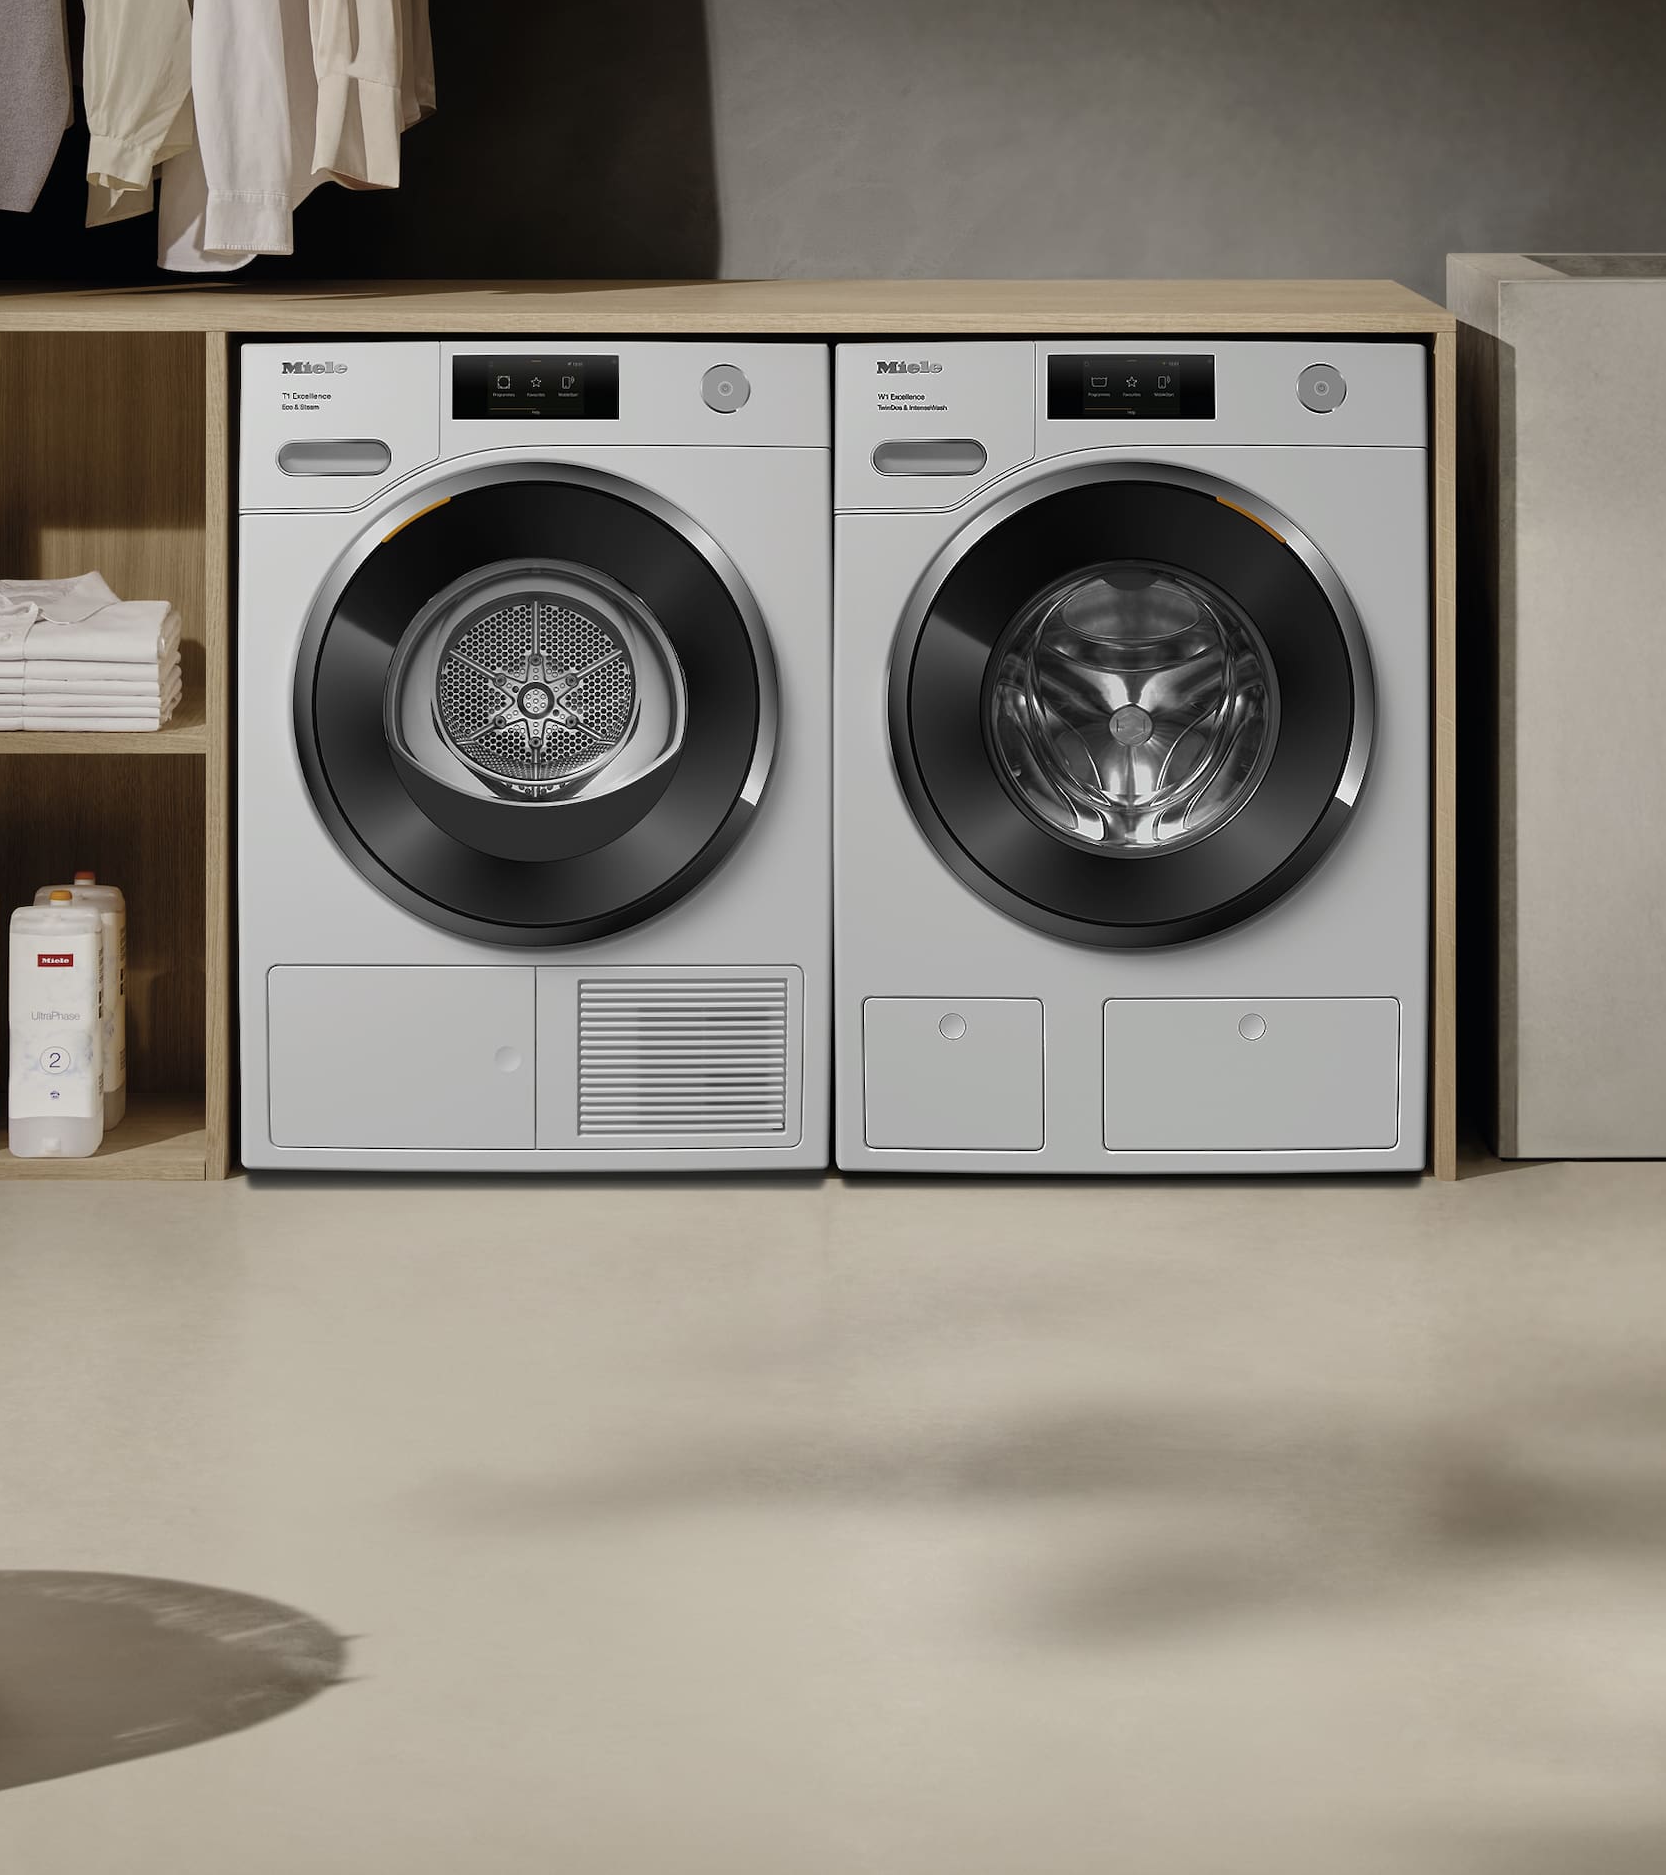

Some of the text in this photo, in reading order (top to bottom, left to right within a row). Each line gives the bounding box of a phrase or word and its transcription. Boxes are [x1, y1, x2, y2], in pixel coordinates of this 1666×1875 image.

[282, 361, 348, 374] Miele
[876, 361, 943, 374] Miele
[282, 392, 332, 400] T1 Excellence
[890, 393, 926, 401] Excellence
[31, 1011, 80, 1021] UltraPhase
[49, 1052, 61, 1068] 2
